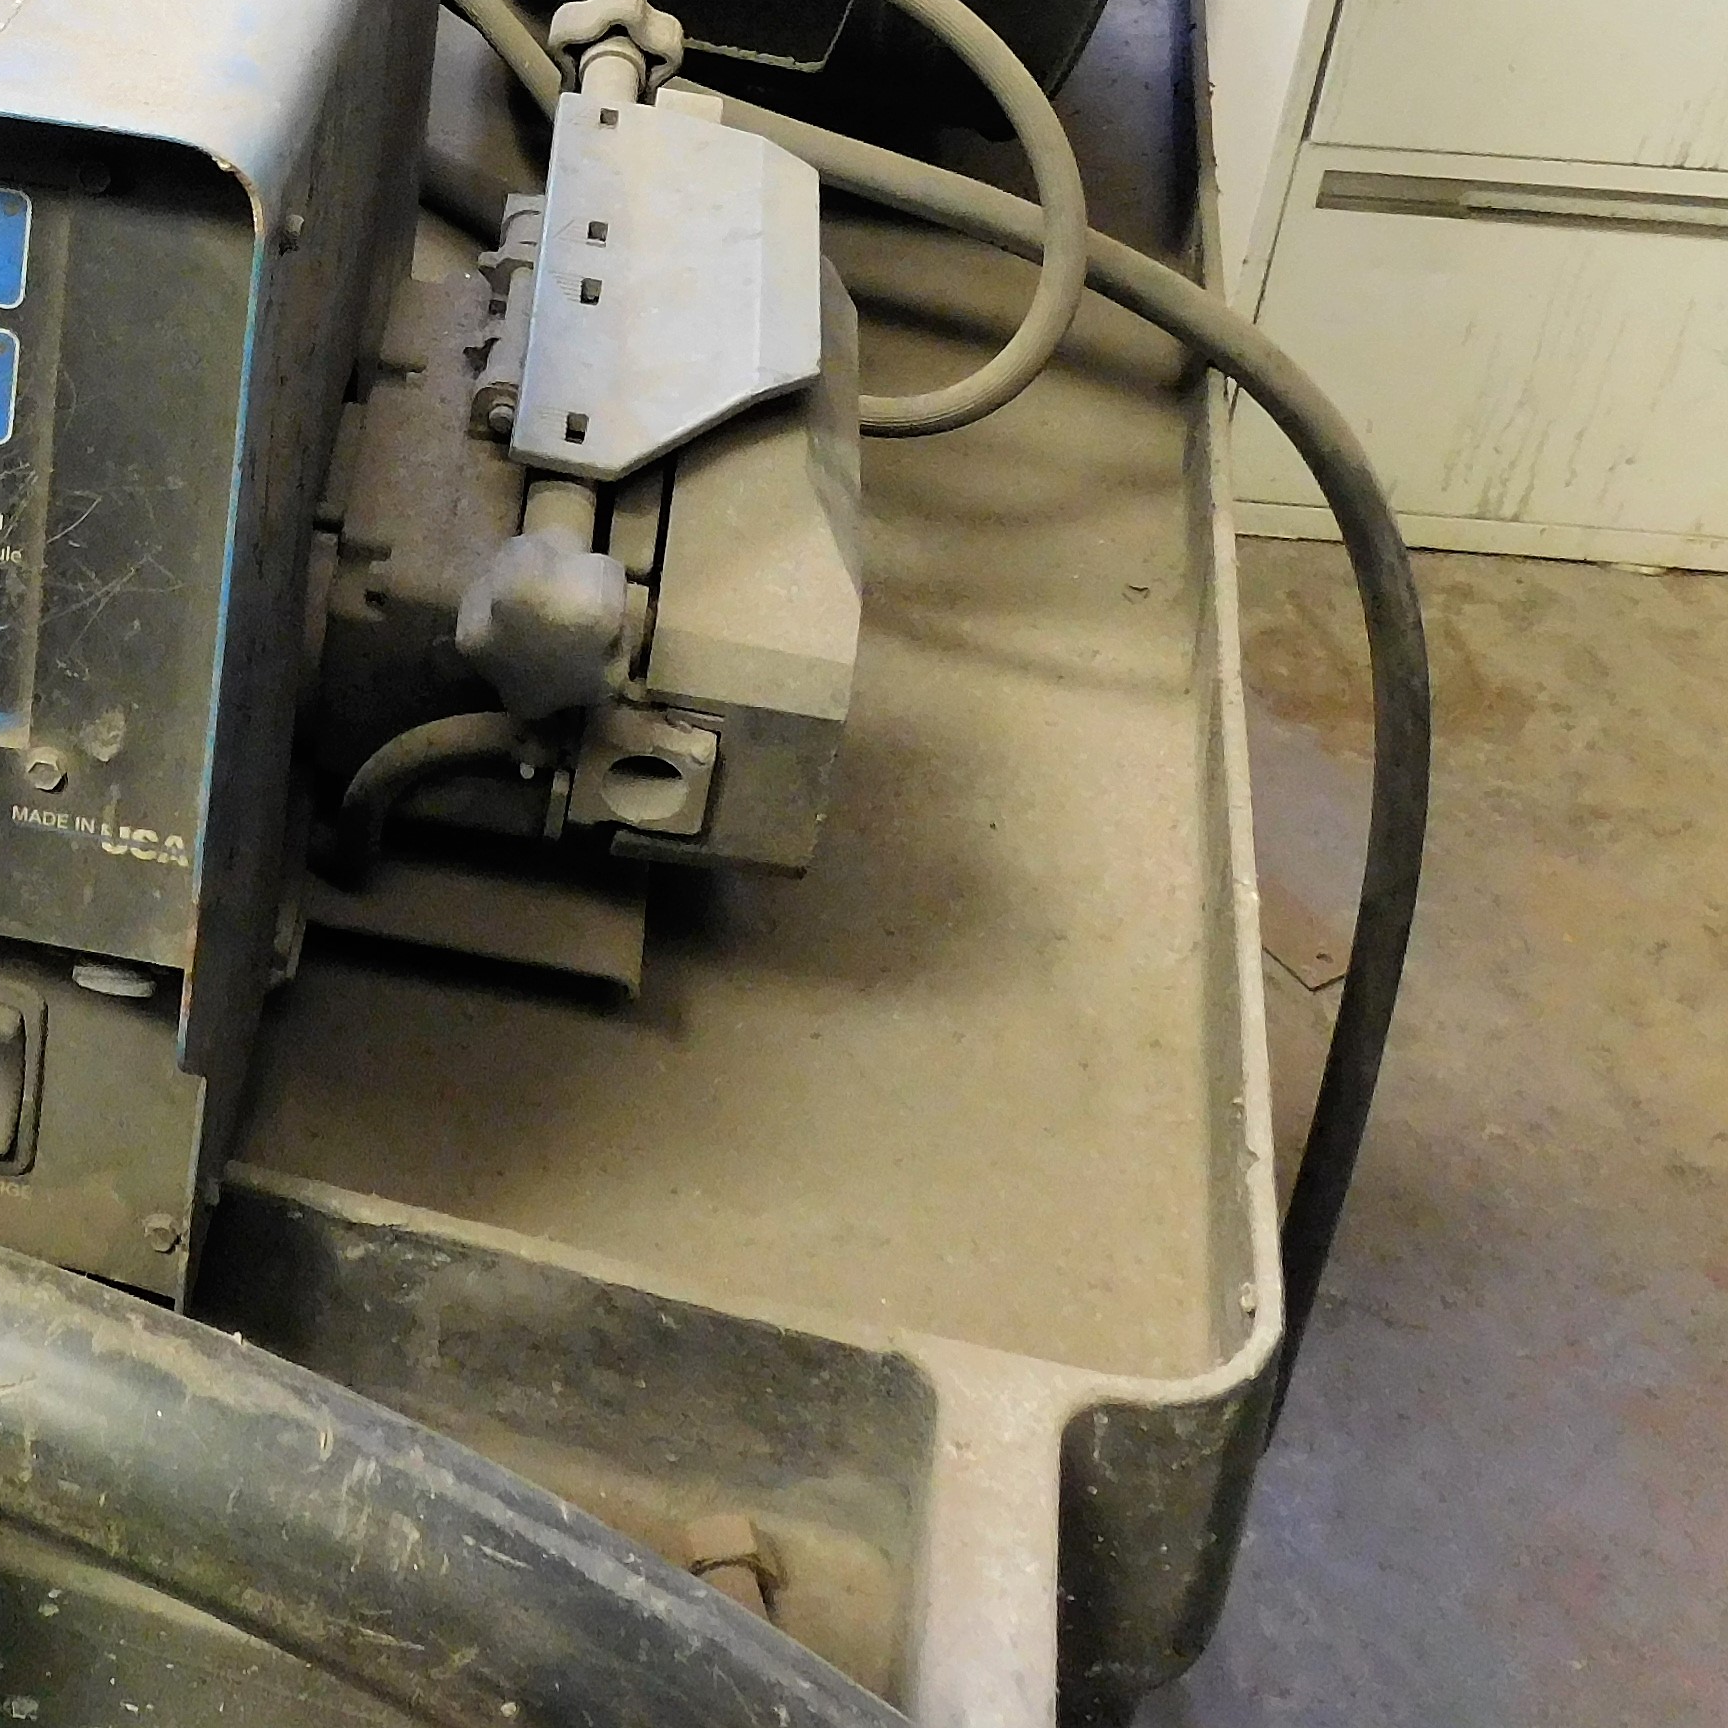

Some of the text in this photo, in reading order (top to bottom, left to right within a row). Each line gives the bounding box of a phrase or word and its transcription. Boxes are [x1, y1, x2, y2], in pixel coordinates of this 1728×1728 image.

[12, 804, 189, 867] MADE IN USA
